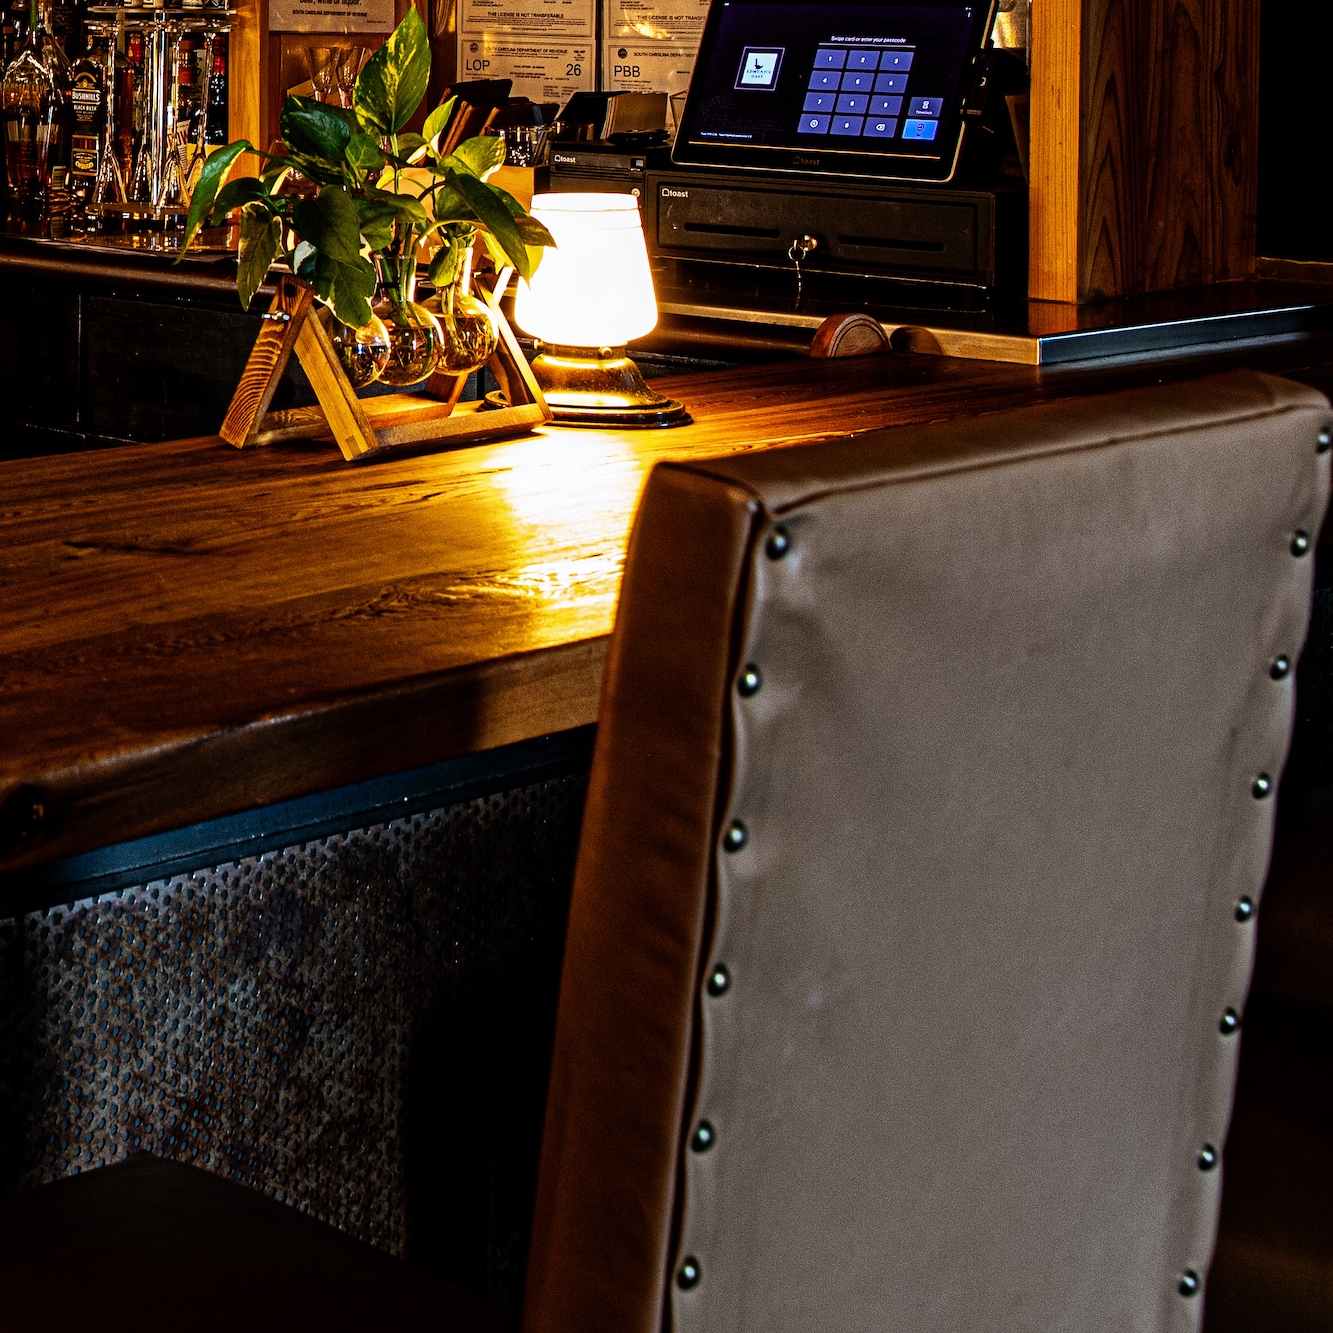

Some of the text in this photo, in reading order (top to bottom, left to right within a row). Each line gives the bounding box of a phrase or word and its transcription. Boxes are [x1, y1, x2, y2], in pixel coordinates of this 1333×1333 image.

[466, 60, 490, 70] LOP
[566, 64, 581, 76] 26
[614, 65, 640, 77] PBB
